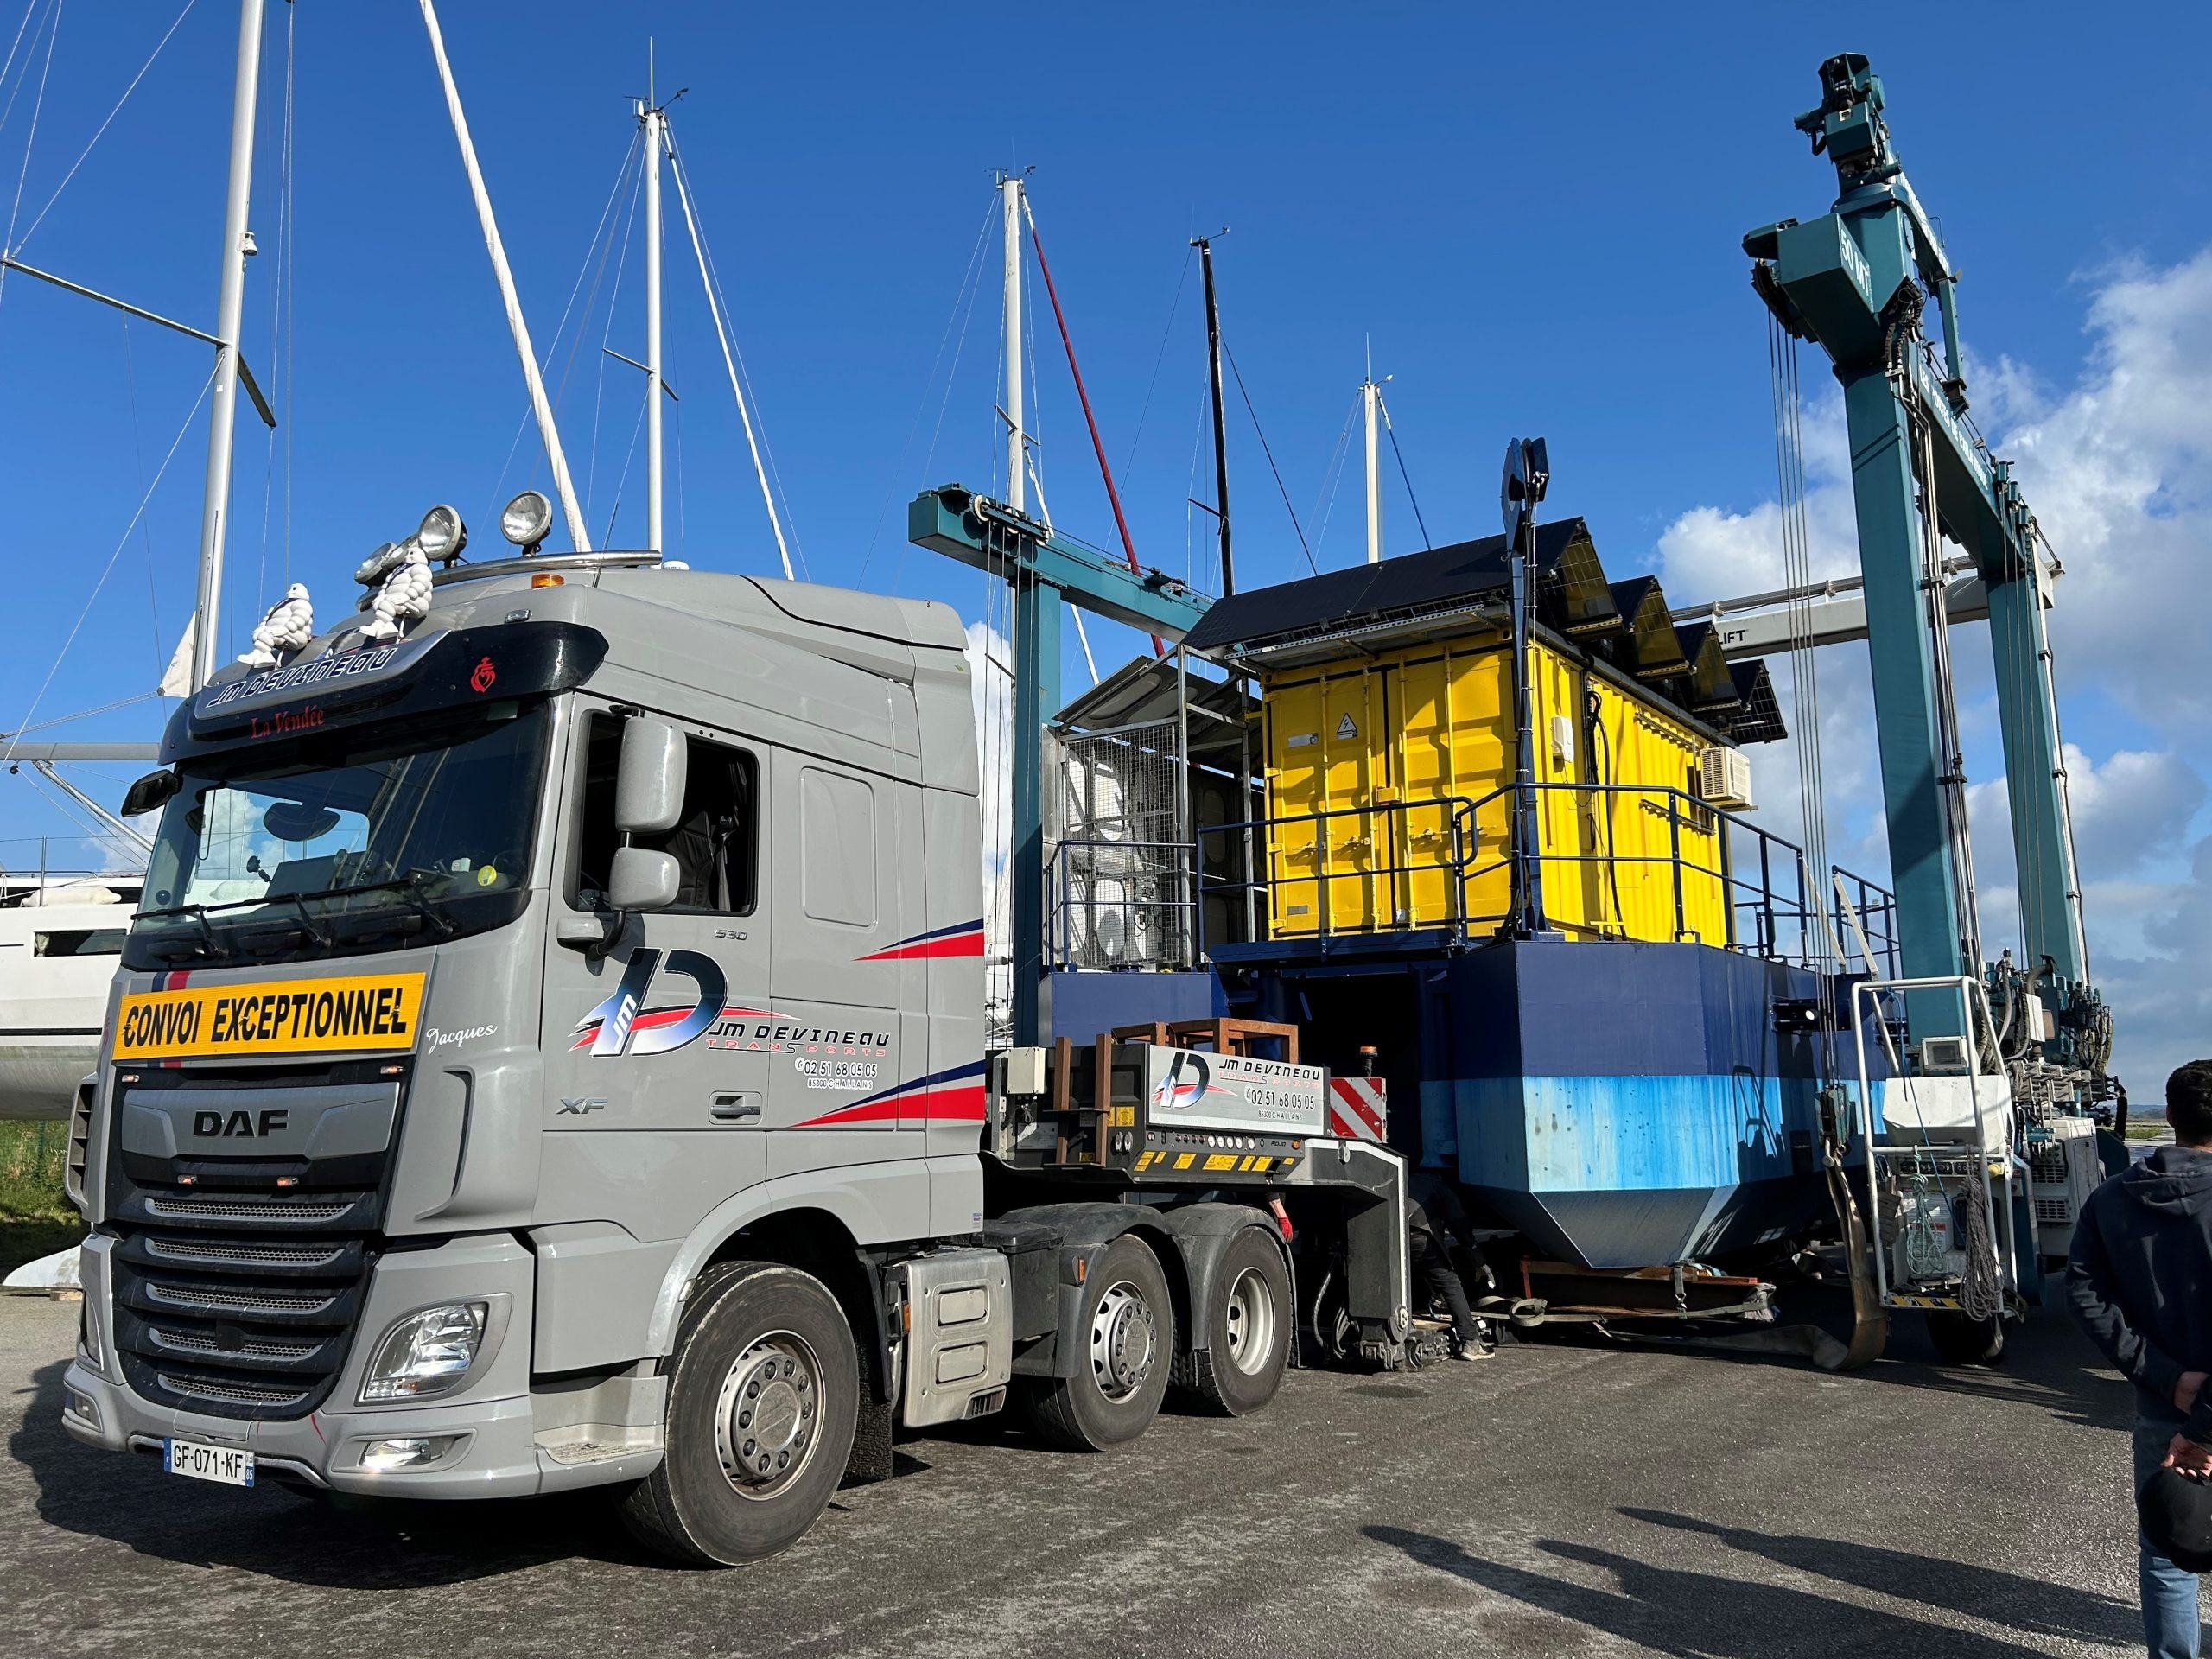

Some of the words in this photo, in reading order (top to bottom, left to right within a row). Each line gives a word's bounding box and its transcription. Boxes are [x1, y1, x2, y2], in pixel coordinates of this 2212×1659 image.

[1840, 228, 1854, 270] 50
[1719, 629, 1746, 645] IFT
[206, 680, 246, 709] JM
[240, 647, 398, 699] DEVINEAU
[251, 716, 270, 740] La
[274, 704, 326, 734] Vendée
[715, 928, 748, 942] 530
[123, 1000, 204, 1048] CONVOI
[210, 987, 407, 1043] EXCEPTIONNEL
[426, 1024, 499, 1055] Jacques
[708, 1022, 745, 1037] JM
[754, 1024, 890, 1046] DEVINEAU
[804, 1061, 817, 1075] 02
[820, 1062, 831, 1076] 51
[836, 1063, 848, 1077] 68
[850, 1063, 862, 1077] 05
[865, 1064, 877, 1077] 05
[1218, 1058, 1239, 1071] JM
[1243, 1061, 1321, 1081] DEVINEAU
[808, 1077, 827, 1089] 85300
[828, 1079, 873, 1090] CHALLANS
[556, 1098, 608, 1115] XF
[1251, 1089, 1262, 1105] 02
[1265, 1090, 1274, 1106] 51
[1279, 1092, 1289, 1108] 68
[1291, 1093, 1302, 1109] 05
[1304, 1095, 1314, 1110] 05
[193, 1109, 290, 1138] DAF
[174, 1444, 244, 1478] GF-071-KF
[245, 1469, 253, 1481] 85
